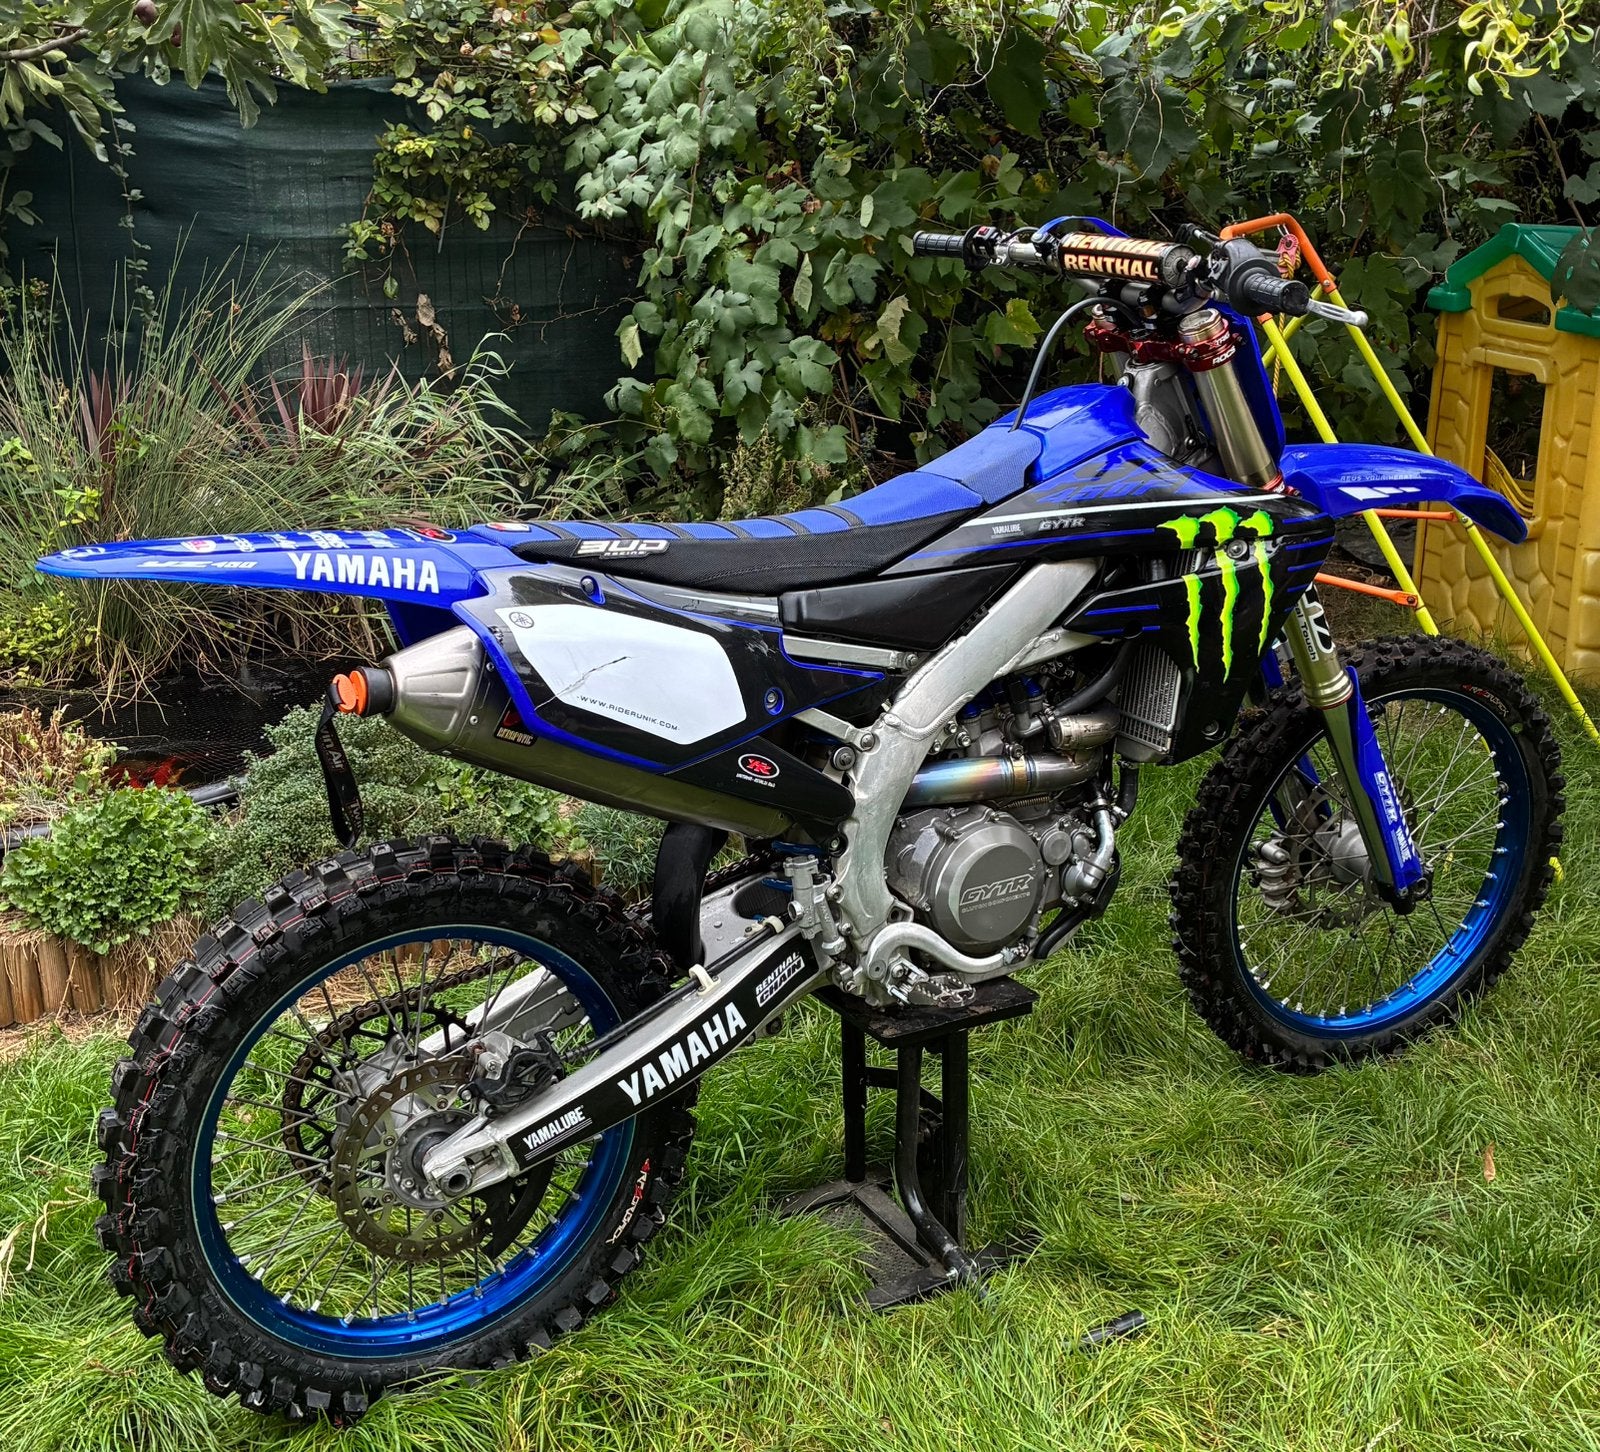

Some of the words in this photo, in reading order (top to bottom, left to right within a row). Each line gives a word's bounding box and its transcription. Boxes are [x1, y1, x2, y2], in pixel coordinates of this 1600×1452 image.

[1062, 233, 1168, 257] RENTHAL
[1063, 254, 1159, 280] RENTHAL
[1038, 516, 1087, 532] GYTR
[577, 539, 669, 555] BUD
[286, 551, 440, 594] YAMAHA
[1300, 622, 1317, 661] Touch
[960, 873, 1035, 906] GYTR
[755, 951, 800, 996] RENTHAL
[758, 957, 804, 1006] CHAIN
[523, 1107, 587, 1150] YAMALUBE
[617, 1001, 747, 1106] YAMAHA
